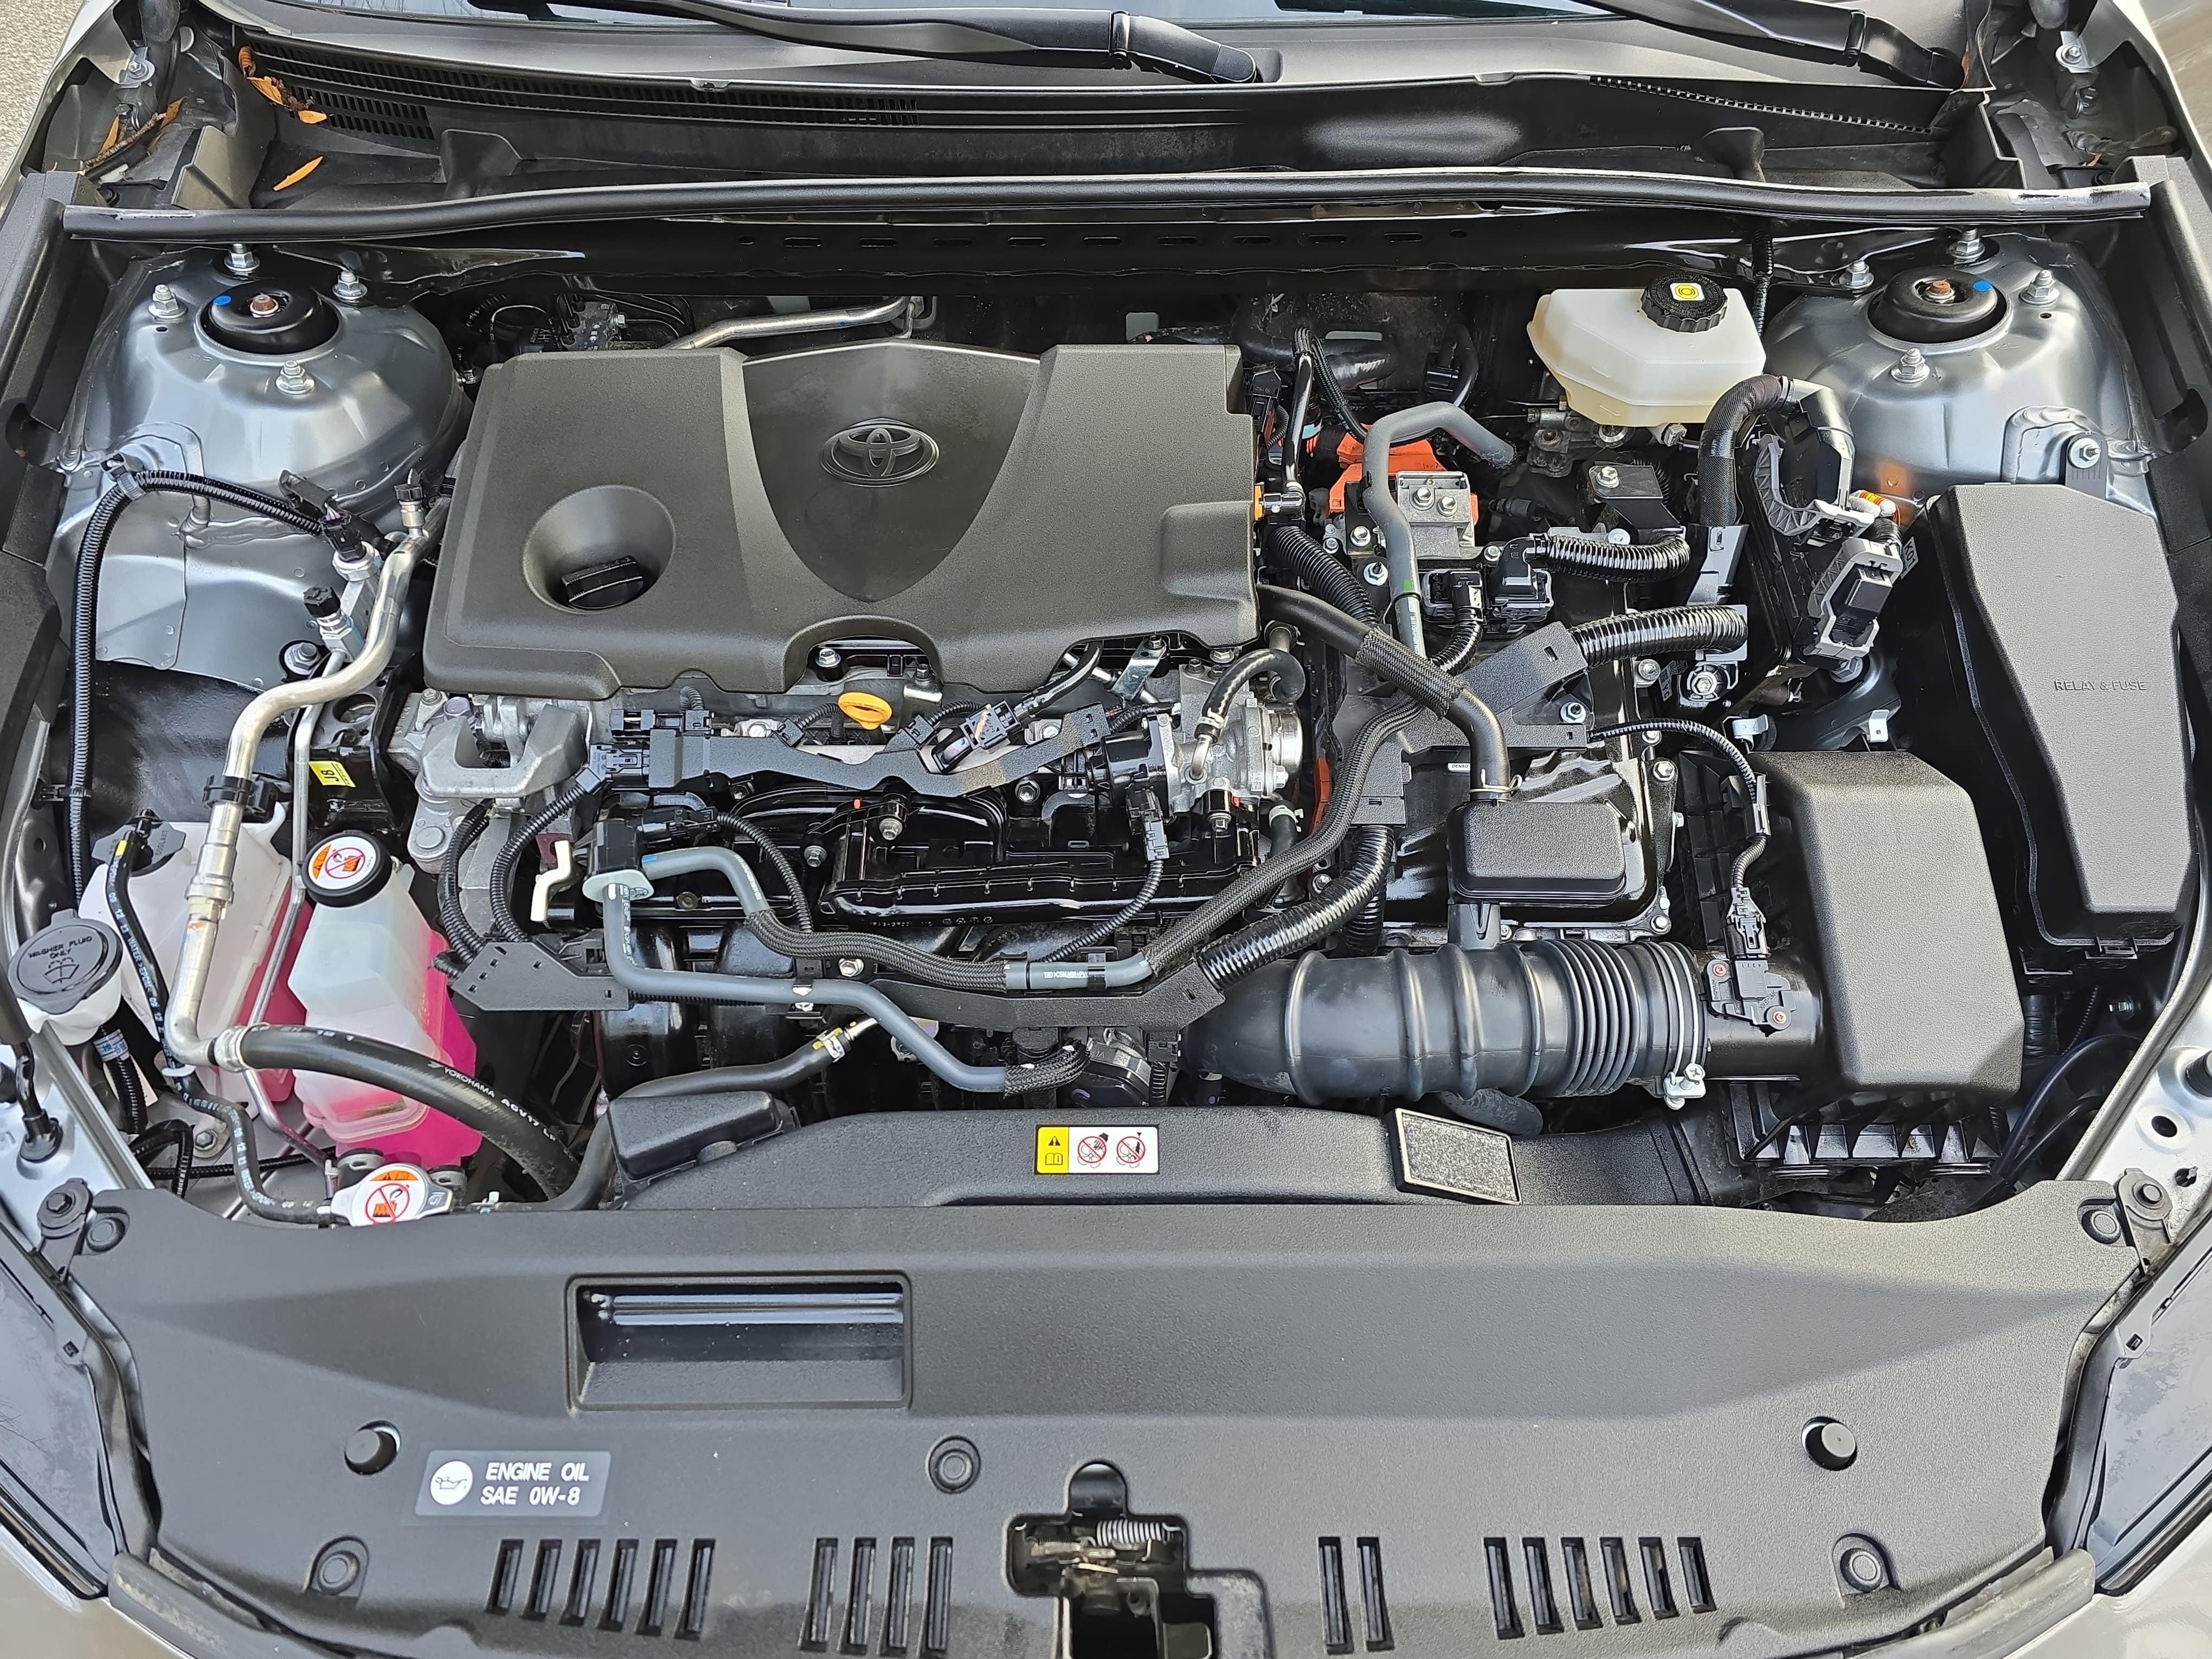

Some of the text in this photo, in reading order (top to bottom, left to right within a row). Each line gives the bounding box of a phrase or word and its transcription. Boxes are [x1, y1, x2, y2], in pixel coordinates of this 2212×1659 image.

[1904, 541, 1916, 568] K01
[2054, 680, 2148, 690] RELAY & FUSE
[320, 770, 339, 782] J8
[69, 936, 93, 947] FLUID
[115, 908, 126, 920] 12
[127, 936, 142, 962] WATER
[49, 948, 72, 959] ONLY
[443, 1066, 495, 1098] YOKOHAMA
[500, 1098, 540, 1127] ACV17
[485, 1462, 590, 1482] ENGINE OIL
[480, 1486, 581, 1506] SAE 0W-8
